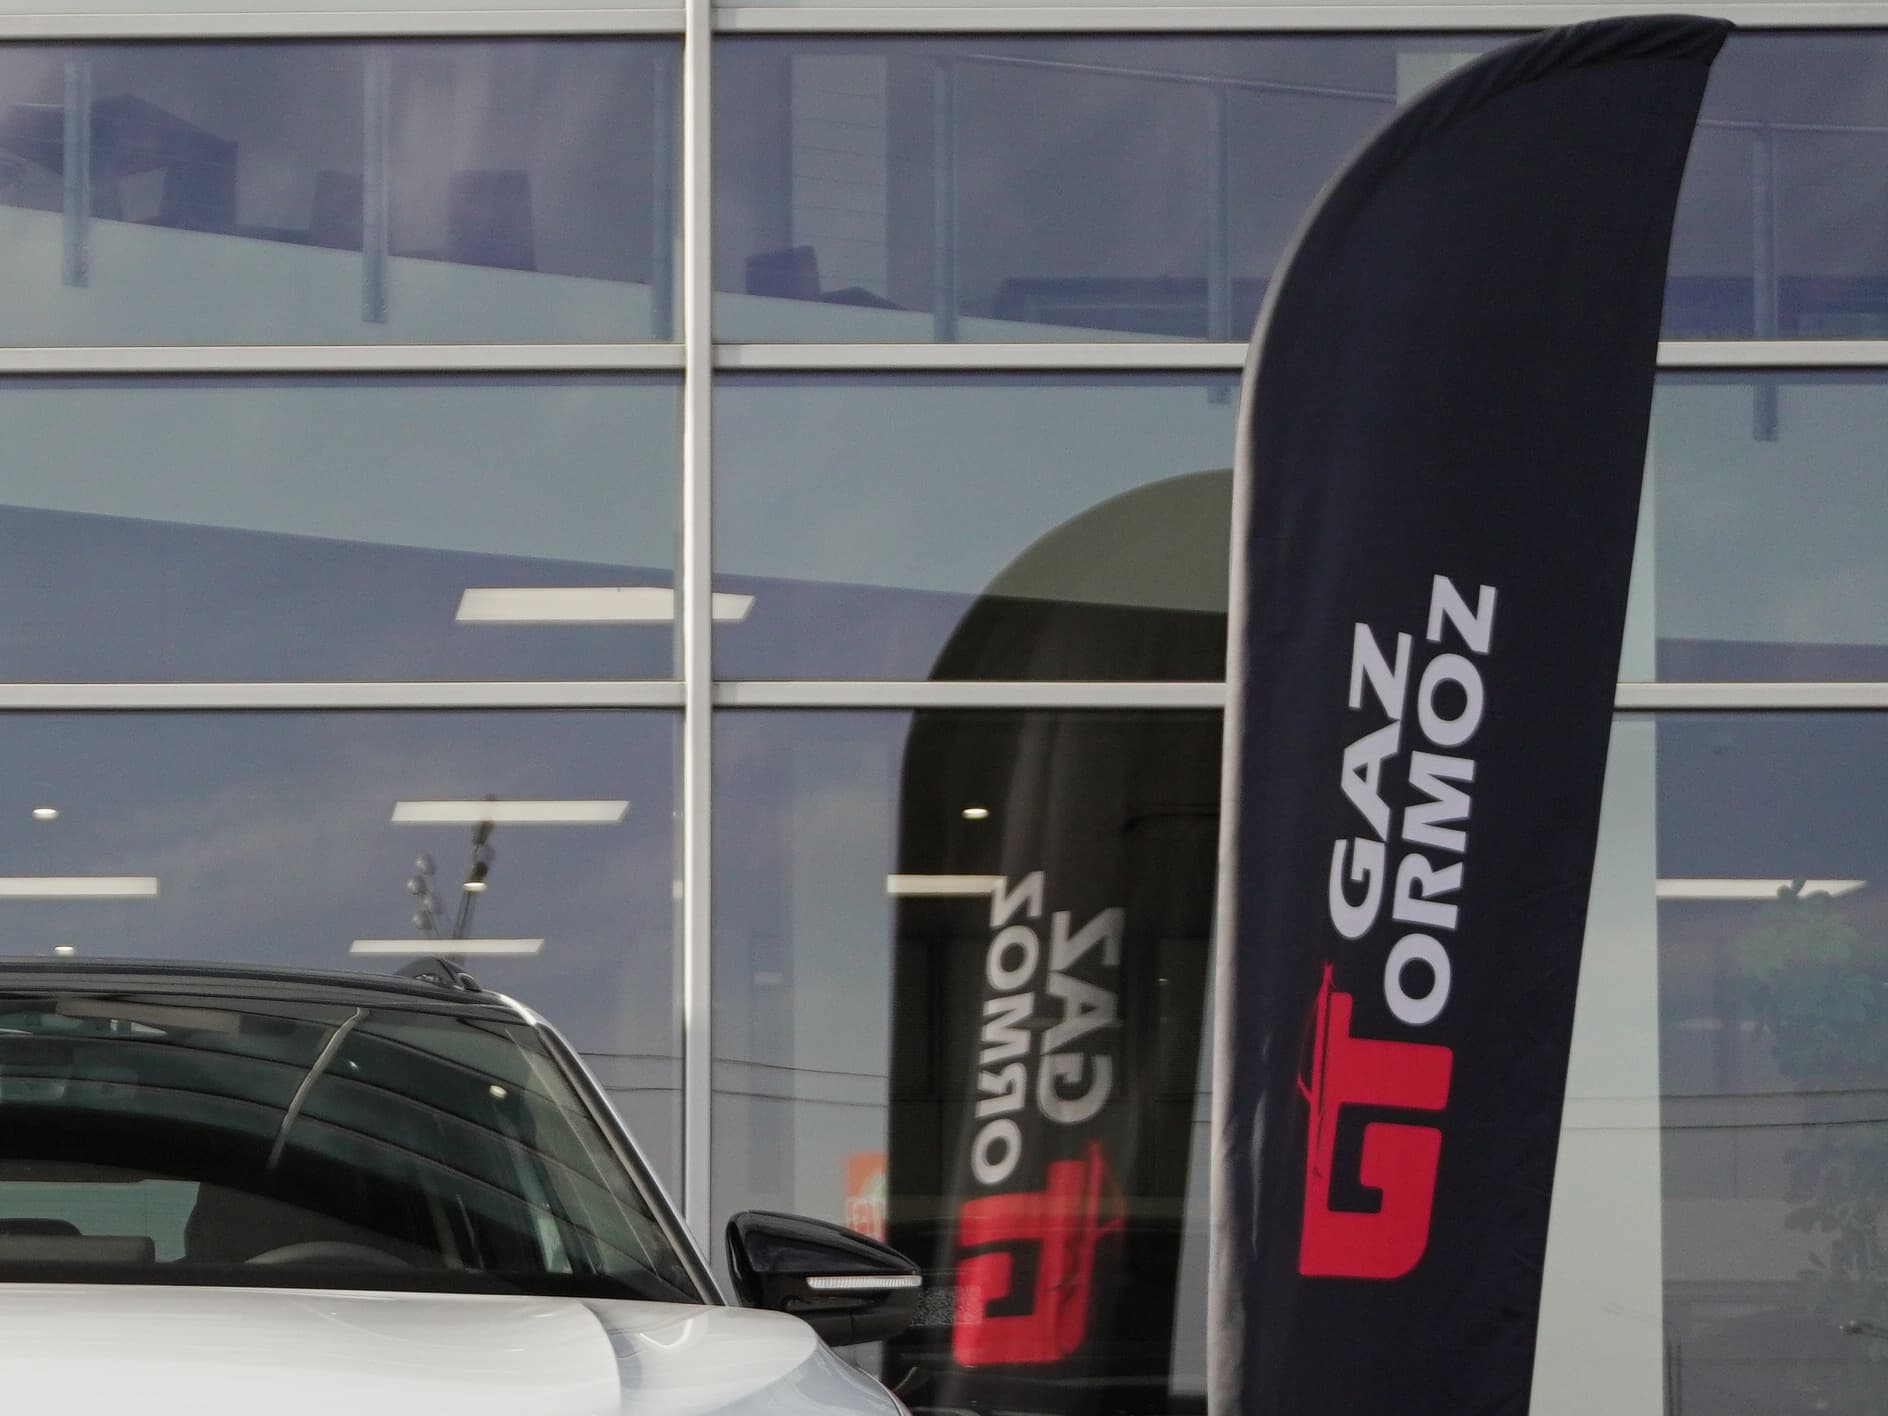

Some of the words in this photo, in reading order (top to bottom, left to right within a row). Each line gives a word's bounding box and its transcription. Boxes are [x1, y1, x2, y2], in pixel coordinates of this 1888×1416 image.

[1329, 622, 1413, 939] GAZ
[1384, 574, 1497, 1026] ORMOZ
[1299, 985, 1454, 1280] GT
